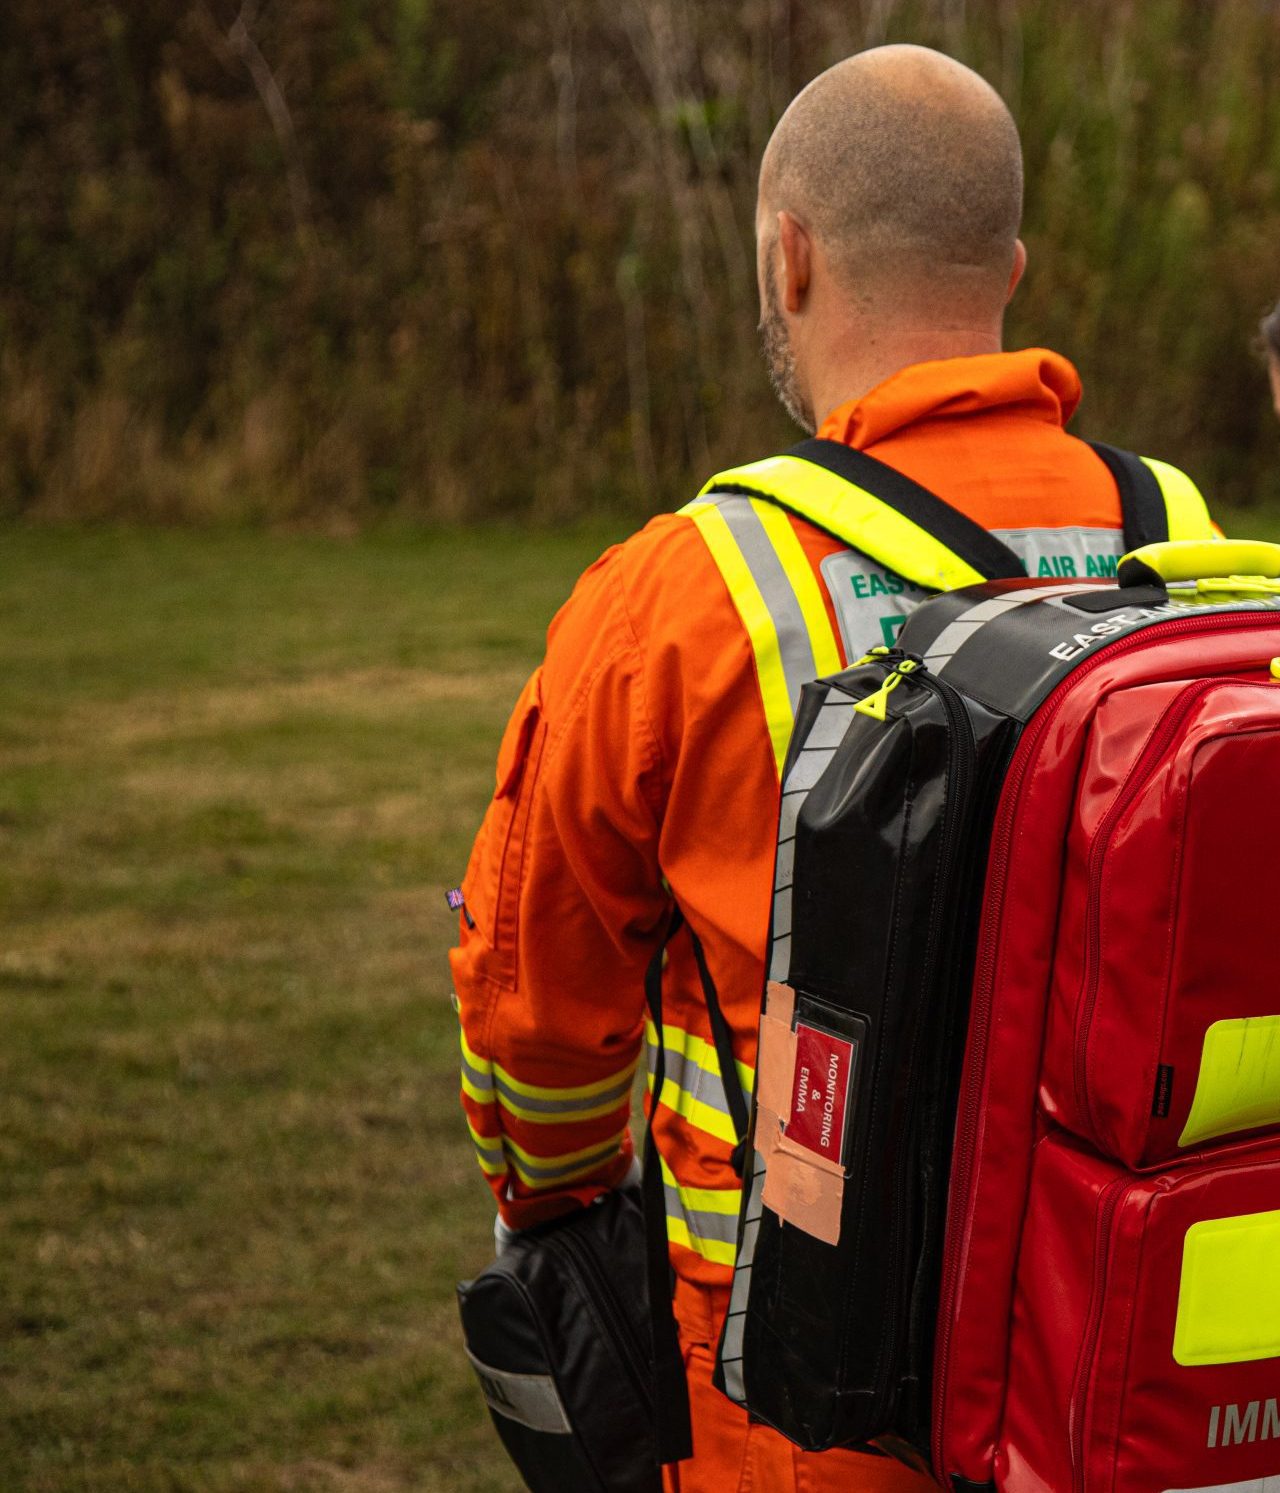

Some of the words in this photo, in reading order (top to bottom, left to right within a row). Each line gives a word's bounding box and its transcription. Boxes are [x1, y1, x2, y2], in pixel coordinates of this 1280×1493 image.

[849, 571, 916, 598] EAS
[1038, 556, 1077, 577] AIR
[1049, 614, 1136, 662] EAST
[796, 1067, 810, 1112] EMMA
[812, 1089, 821, 1100] &
[820, 1053, 839, 1148] MONITORING
